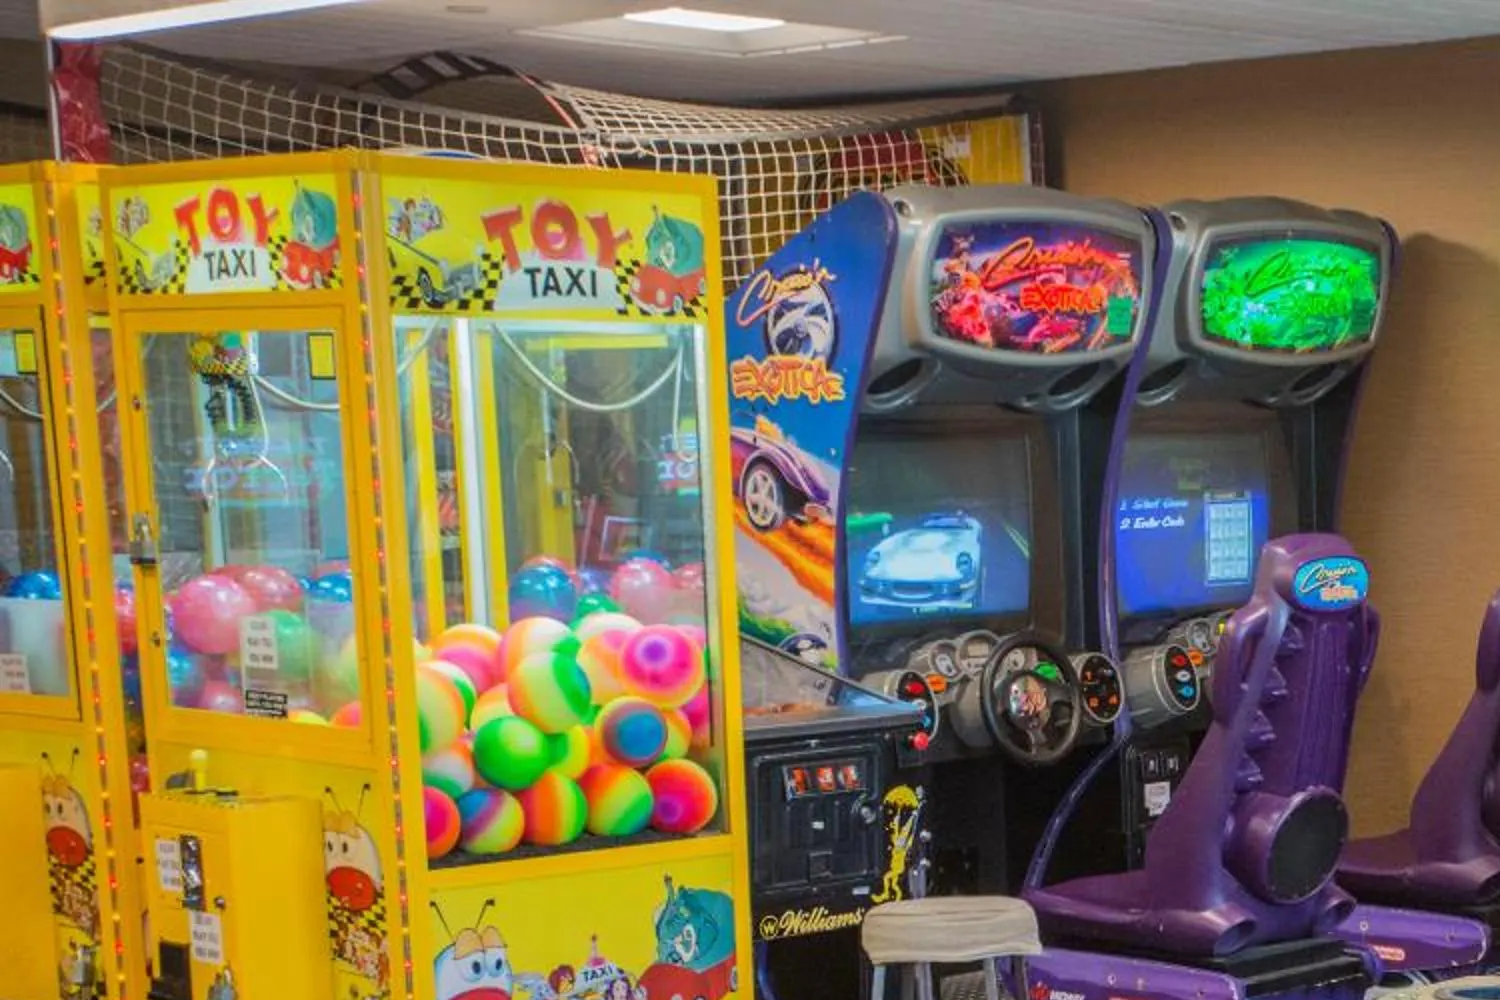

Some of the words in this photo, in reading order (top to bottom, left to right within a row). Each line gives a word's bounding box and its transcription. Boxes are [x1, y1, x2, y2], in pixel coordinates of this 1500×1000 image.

[173, 187, 280, 259] TOY
[480, 199, 632, 273] TOY
[204, 248, 256, 281] TAXI
[524, 267, 598, 298] TAXI
[780, 906, 864, 937] Williams
